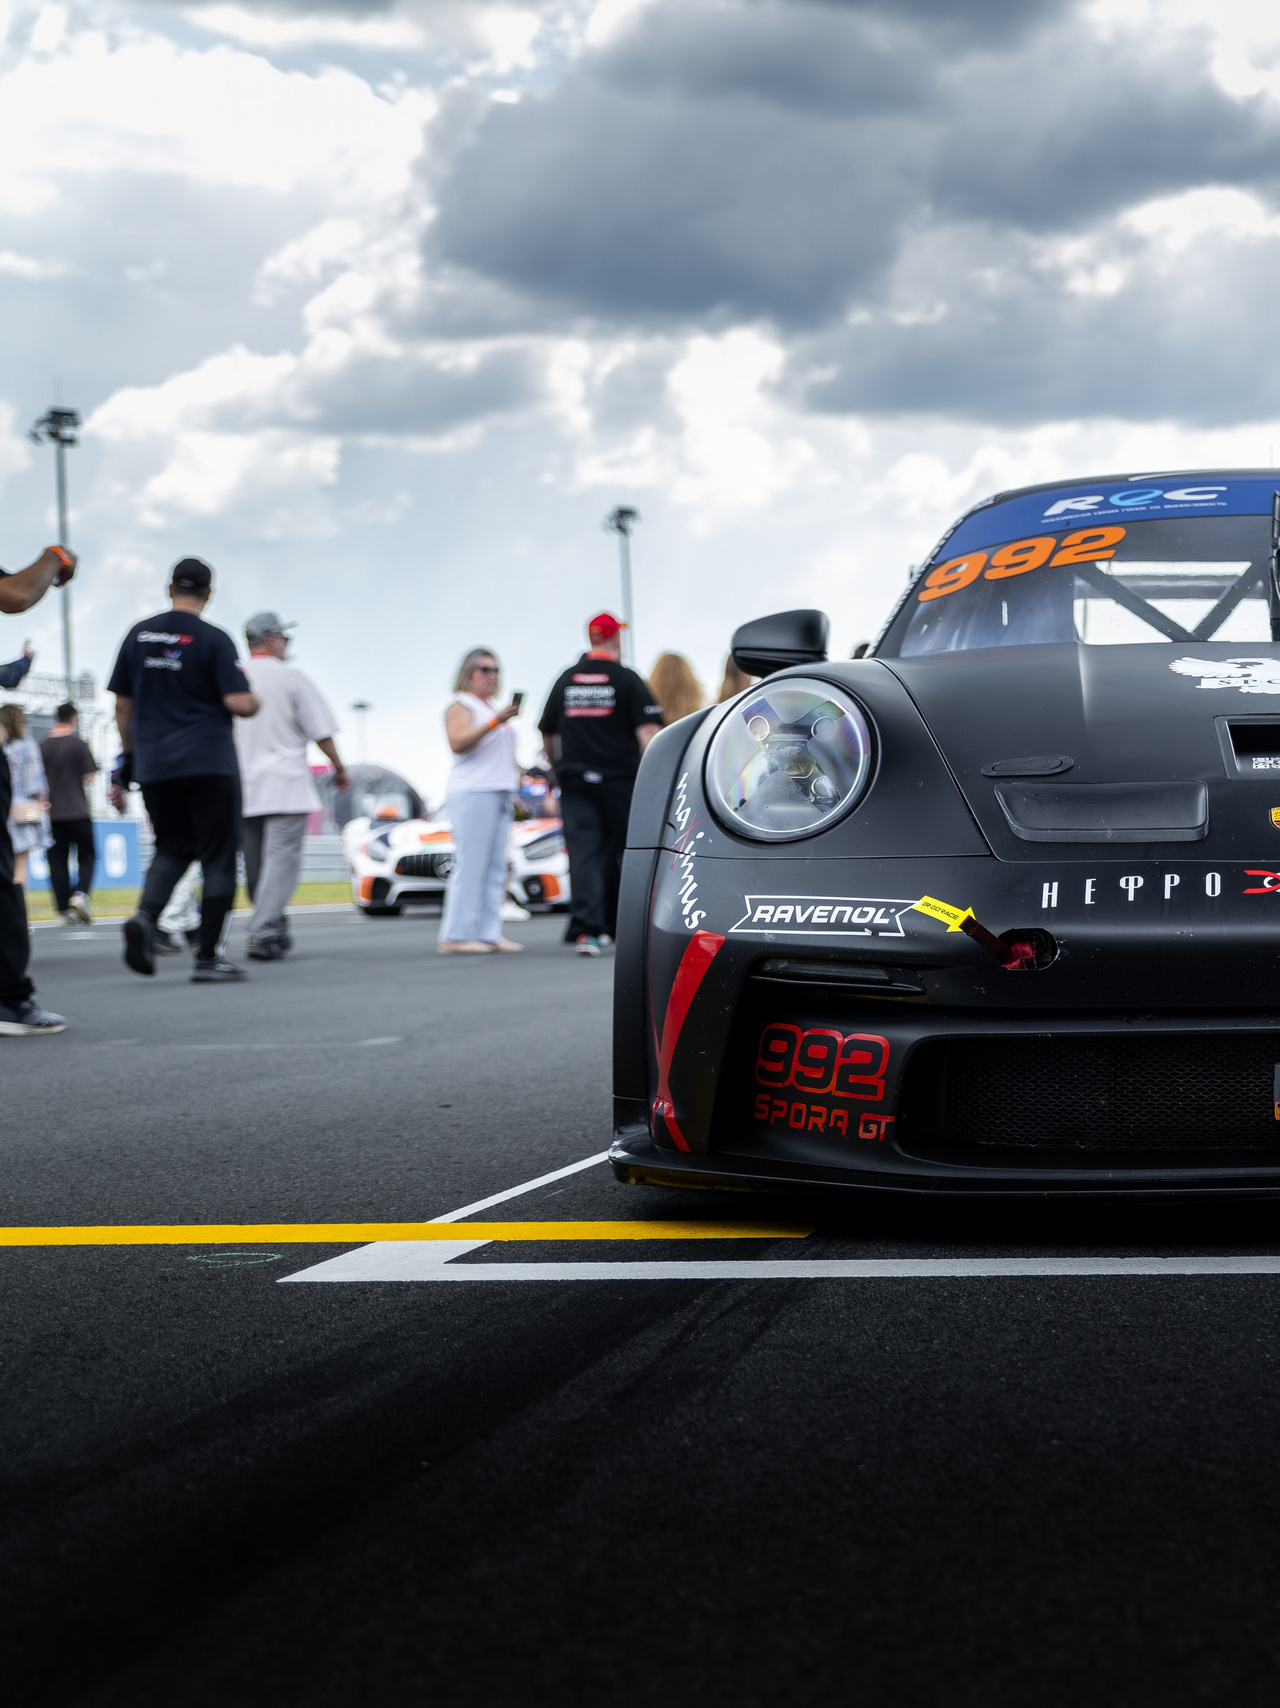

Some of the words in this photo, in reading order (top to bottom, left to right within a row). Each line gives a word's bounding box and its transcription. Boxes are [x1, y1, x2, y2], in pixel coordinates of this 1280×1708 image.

[917, 526, 1127, 602] 992
[755, 1022, 890, 1101] 992
[754, 1093, 848, 1136] SPORA
[859, 1113, 895, 1141] GT
